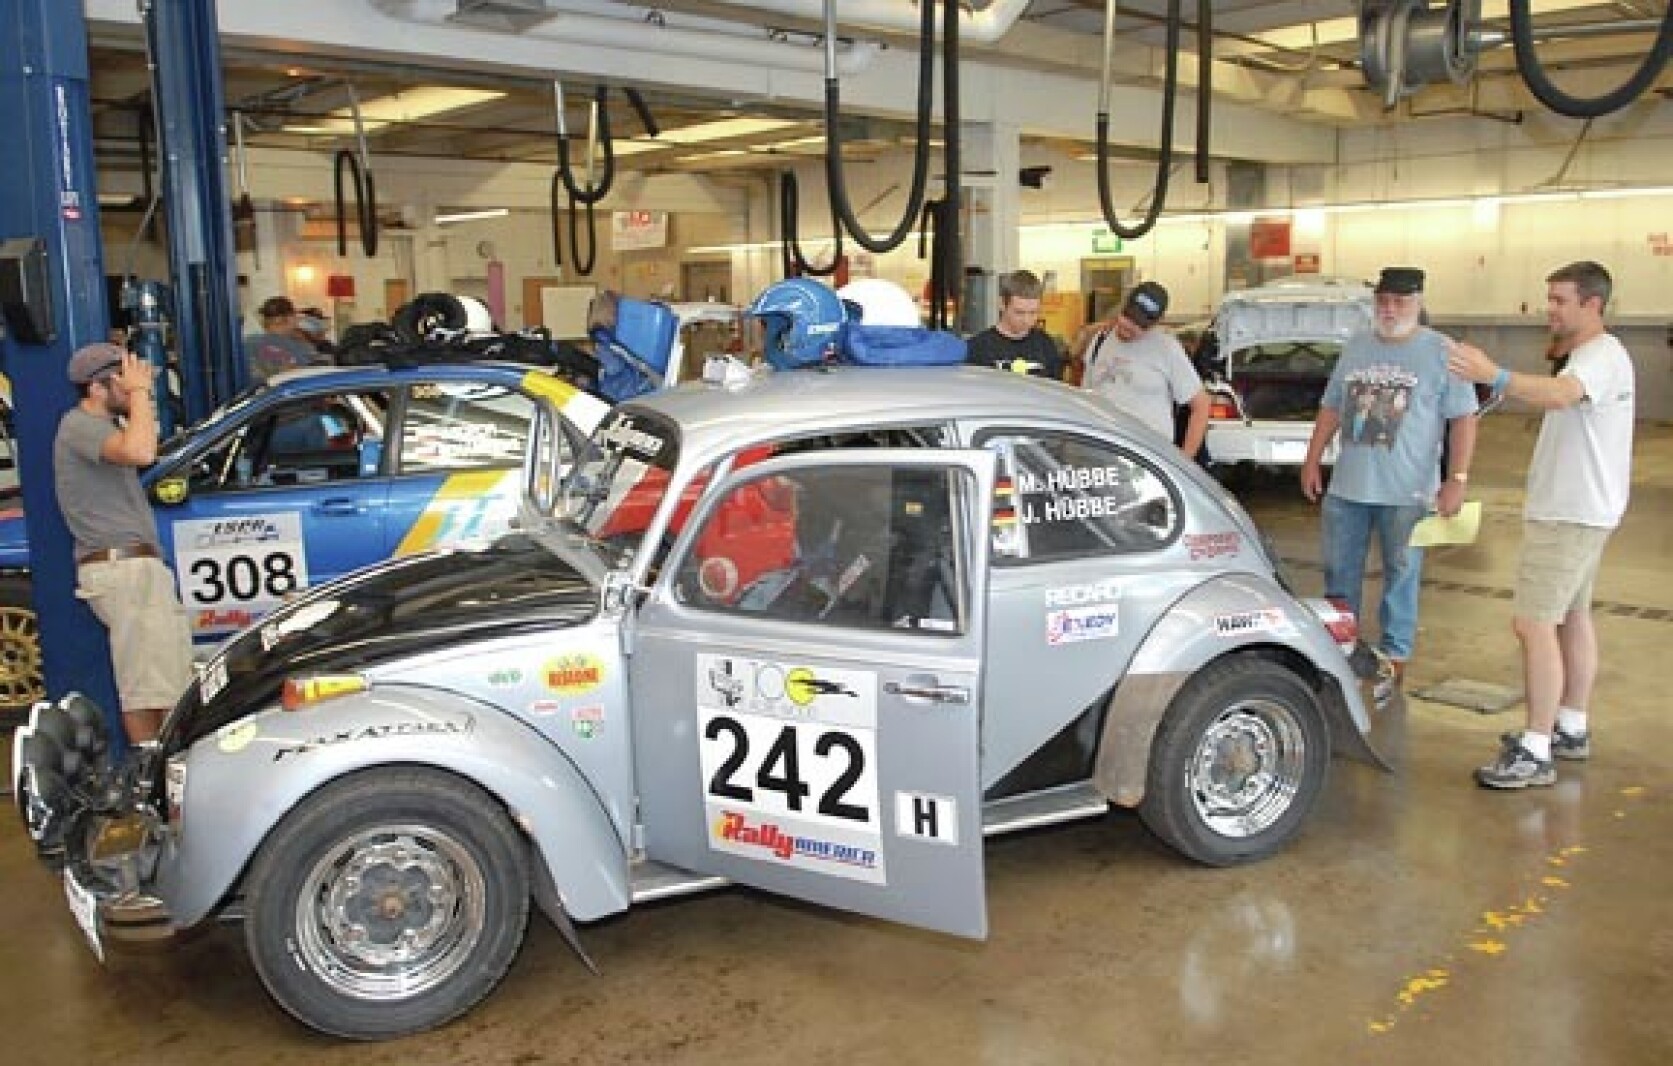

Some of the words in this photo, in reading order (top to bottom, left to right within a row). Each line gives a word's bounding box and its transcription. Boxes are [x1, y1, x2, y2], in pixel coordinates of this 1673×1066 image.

[1047, 464, 1119, 491] HÜBBE
[1045, 496, 1118, 520] HÜBBE
[190, 551, 297, 604] 308
[705, 715, 870, 823] 242
[721, 810, 794, 860] Rally
[913, 795, 940, 838] H
